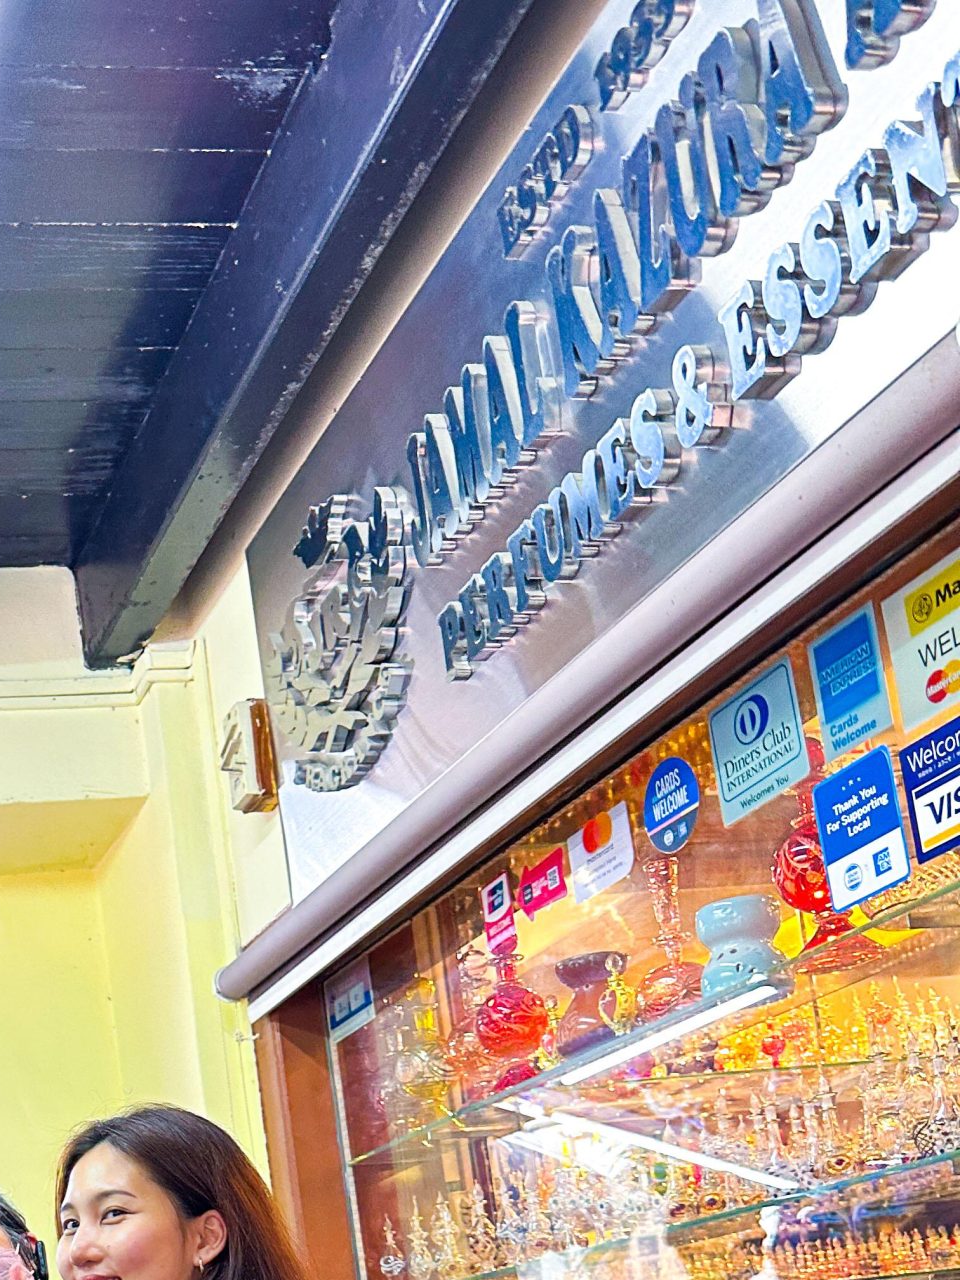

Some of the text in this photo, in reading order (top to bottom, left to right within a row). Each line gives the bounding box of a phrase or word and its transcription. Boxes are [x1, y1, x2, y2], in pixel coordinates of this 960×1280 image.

[406, 0, 816, 568] JAMAL KAZURA
[438, 387, 666, 680] PERFUMES
[672, 346, 710, 448] &
[819, 641, 870, 686] AMERICAN
[830, 711, 859, 737] Cards
[832, 718, 877, 751] Welcome
[724, 722, 791, 778] Diners Club
[655, 768, 681, 796] CARDS
[727, 744, 793, 792] INTERNATIONAL
[652, 788, 689, 822] WELCOME
[740, 774, 789, 809] Welcomes You
[832, 785, 877, 816] Thank You
[826, 793, 889, 835] For Supporting
[847, 816, 871, 837] Local
